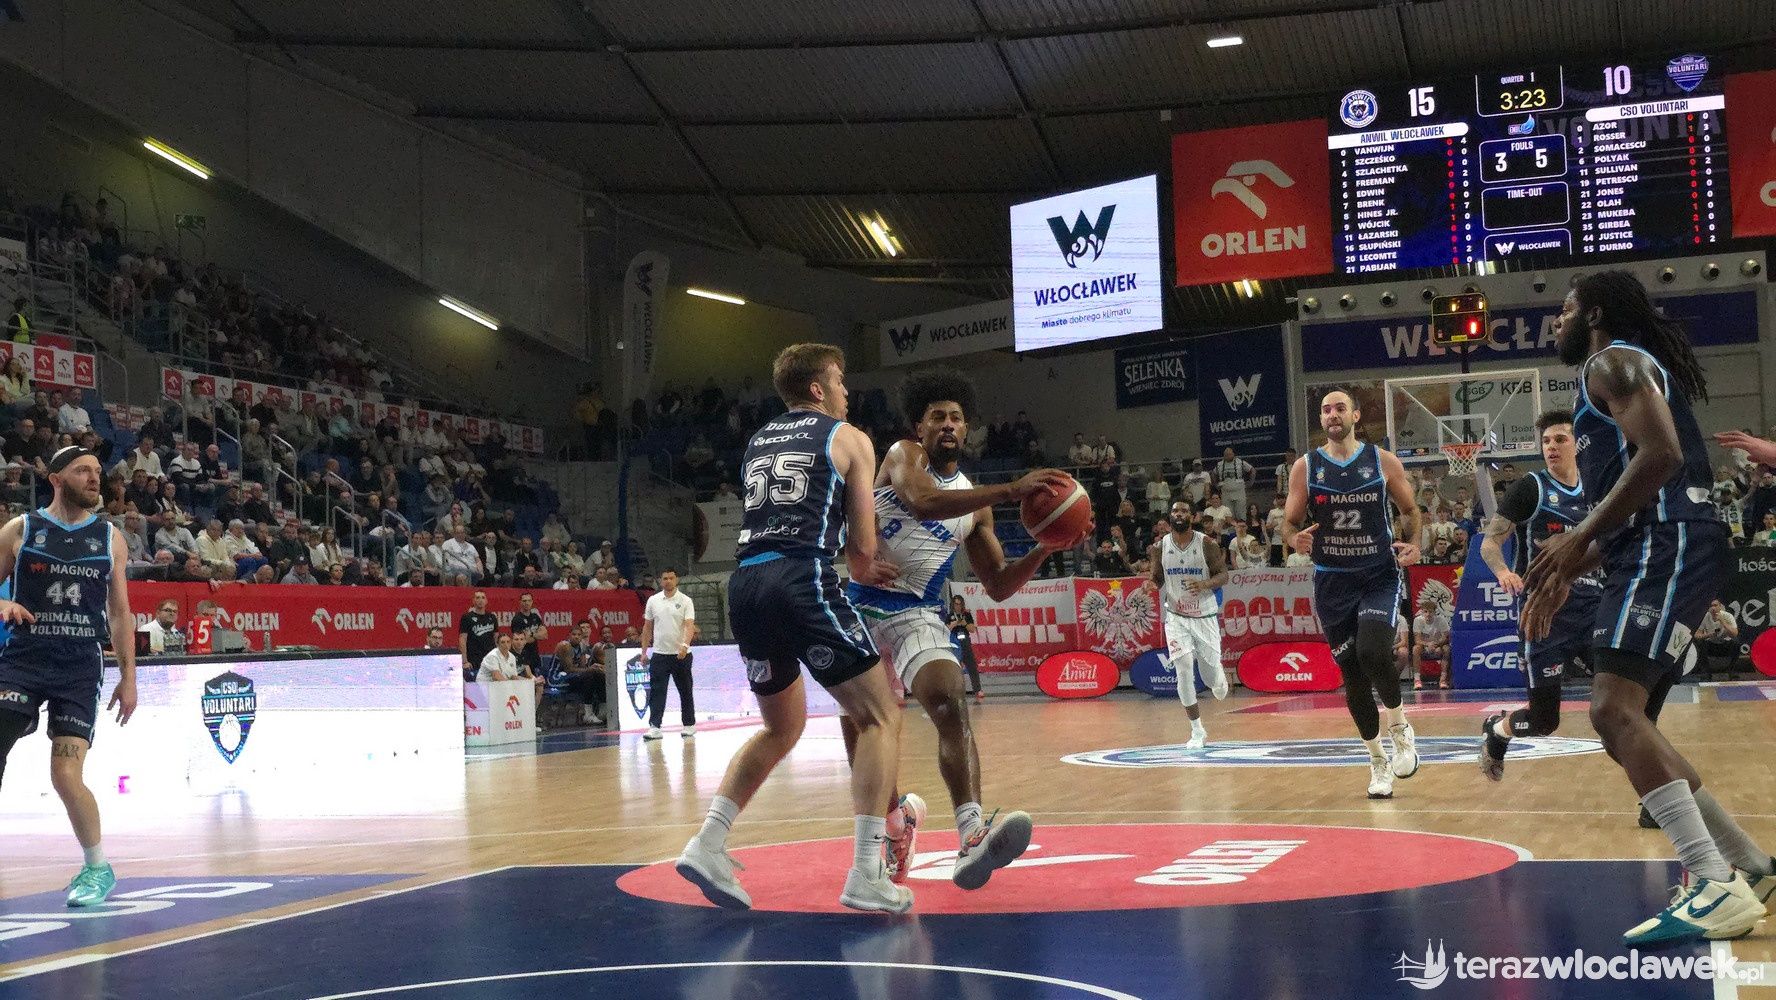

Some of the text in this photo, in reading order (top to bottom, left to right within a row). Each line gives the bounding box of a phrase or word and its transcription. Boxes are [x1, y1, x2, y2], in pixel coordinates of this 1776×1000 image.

[1668, 63, 1707, 73] VOLUNTARI
[1501, 72, 1534, 84] QUARTER 1
[1603, 65, 1632, 96] 10
[1408, 86, 1435, 117] 15
[1500, 89, 1546, 110] 3:23
[1620, 101, 1688, 117] CSO VOLUNTARI
[1593, 121, 1617, 130] AZOR
[1361, 126, 1444, 144] ANWIL WŁOCŁAWEK
[1594, 132, 1626, 141] ROSSER
[1355, 145, 1394, 155] VANWIJN
[1511, 141, 1533, 151] FOULS
[1594, 141, 1646, 152] SOMACESCU
[1495, 148, 1547, 172] 3 5
[1595, 154, 1629, 163] POLYAK
[1356, 165, 1408, 176] SZLACHETKA
[1595, 164, 1637, 174] SULLIVAN
[1356, 177, 1395, 187] FREEMAN
[1596, 175, 1638, 185] PETRESCU
[1357, 188, 1385, 198] EDWIN
[1507, 187, 1543, 199] TIME-OUT
[1596, 188, 1624, 196] JONES
[1357, 199, 1385, 208] BRENK
[1597, 199, 1621, 207] OLAH
[1358, 210, 1382, 219] HINES
[1386, 209, 1398, 217] JR.
[1598, 209, 1635, 218] MUKEBA
[1358, 219, 1390, 229] WÓJCIK
[1598, 220, 1630, 229] GIRBEA
[1358, 230, 1398, 240] ŁAZARSKI
[1599, 231, 1633, 241] JUSTICE
[1201, 225, 1306, 258] ORLEN
[1518, 241, 1561, 251] WŁOCŁAWEK
[1599, 242, 1633, 252] DURMO
[1360, 252, 1397, 261] LECOMTE
[1360, 263, 1396, 272] PABIJAN
[1034, 273, 1137, 307] WŁOCŁAWEK
[1042, 308, 1131, 328] Miasto dobrego klimatu
[929, 315, 1007, 344] WŁOCŁAWEK
[1125, 358, 1186, 387] SELENKA
[1161, 380, 1185, 391] ZDRÓJ
[766, 417, 818, 431] DURMO
[1210, 415, 1275, 433] WŁOCŁAWEK
[745, 452, 816, 512] 55
[1331, 493, 1378, 504] MAGNOR
[1332, 509, 1362, 530] 22
[1322, 545, 1378, 556] VOLUNTARI
[50, 563, 100, 579] MAGNOR
[1232, 572, 1308, 587] Ojczyzna jest
[46, 581, 82, 606] 44
[234, 612, 280, 631] ORLEN
[334, 612, 375, 631] ORLEN
[415, 611, 452, 628] ORLEN
[543, 611, 573, 626] ORLEN
[603, 610, 629, 625] ORLEN
[30, 625, 96, 637] VOLUNTARI
[198, 620, 210, 645] 5
[1467, 652, 1519, 670] PGE
[1058, 661, 1097, 682] Anwil
[1275, 673, 1312, 681] ORLEN
[222, 682, 237, 694] CSO
[203, 698, 256, 714] VOLUNTARI
[504, 720, 523, 731] ORLEN
[1134, 839, 1308, 886] ORLEN
